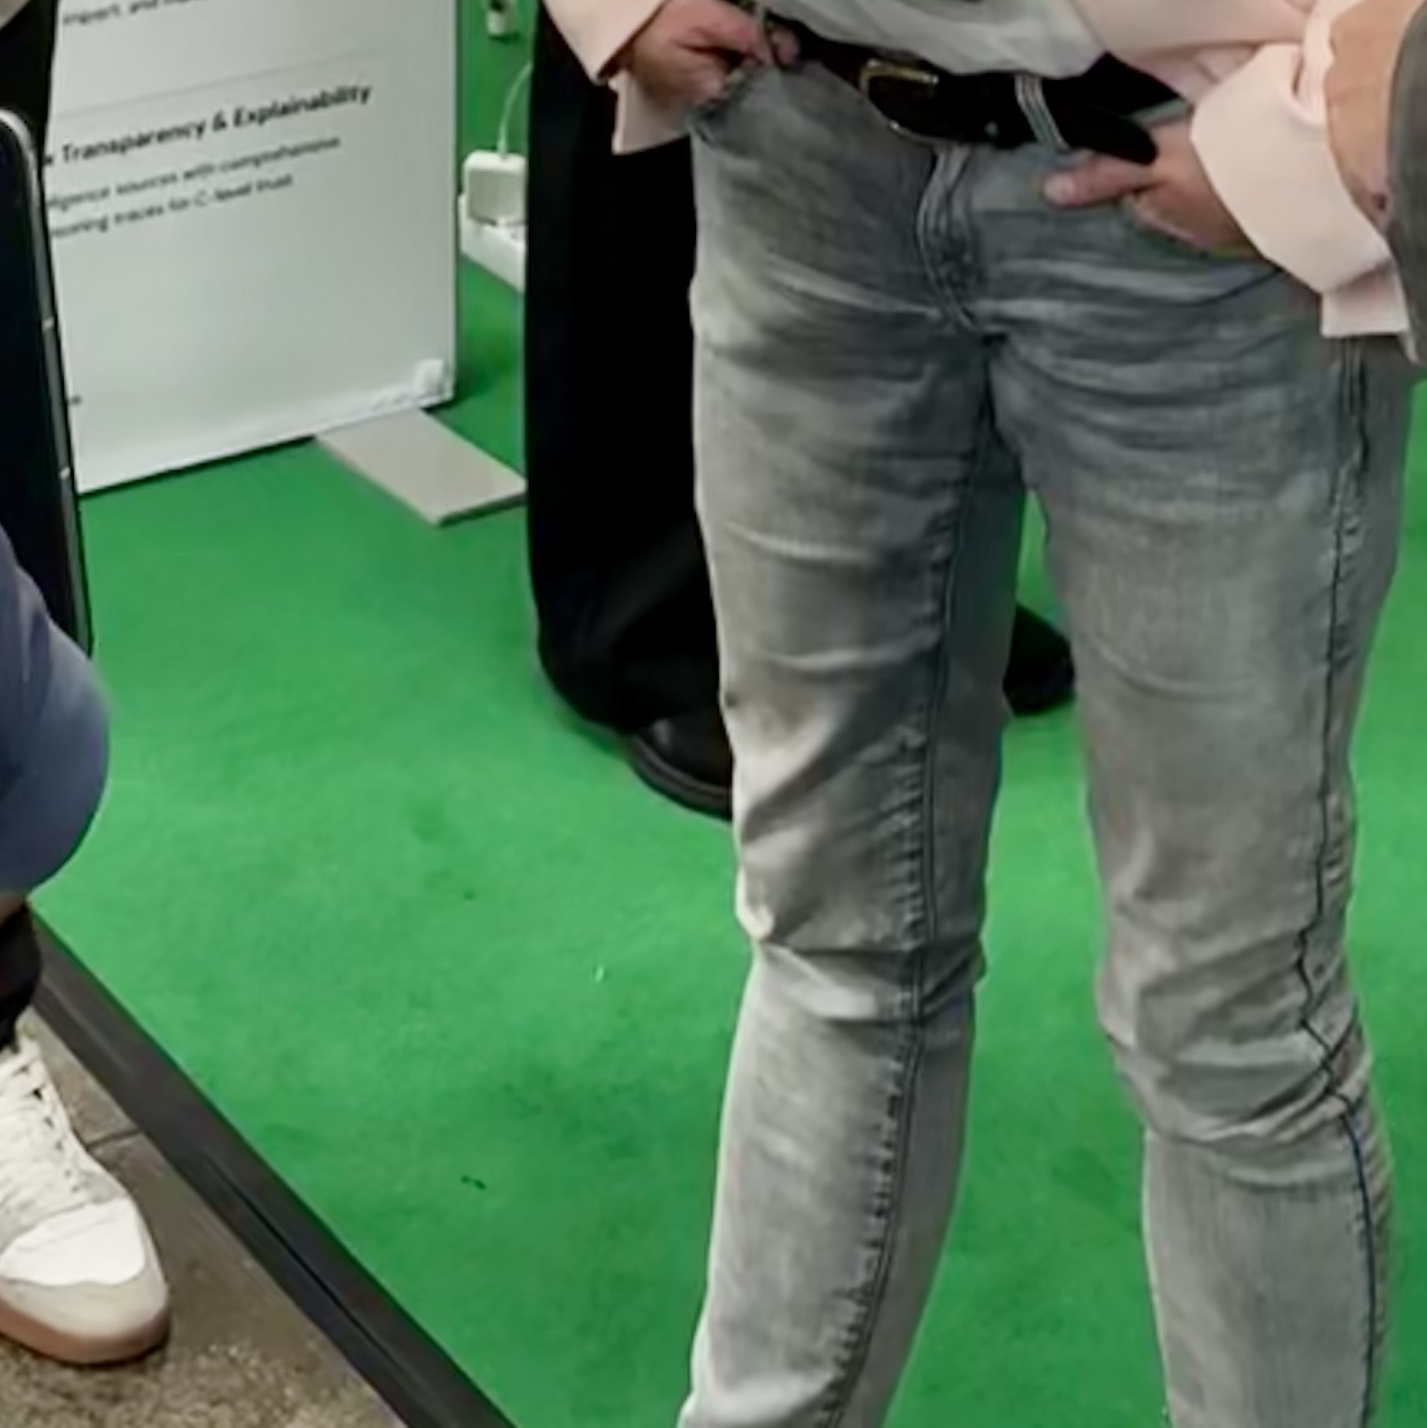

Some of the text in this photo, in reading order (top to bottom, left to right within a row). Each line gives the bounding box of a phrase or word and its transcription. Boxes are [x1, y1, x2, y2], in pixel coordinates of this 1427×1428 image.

[62, 85, 372, 163] Transparency & Explainability
